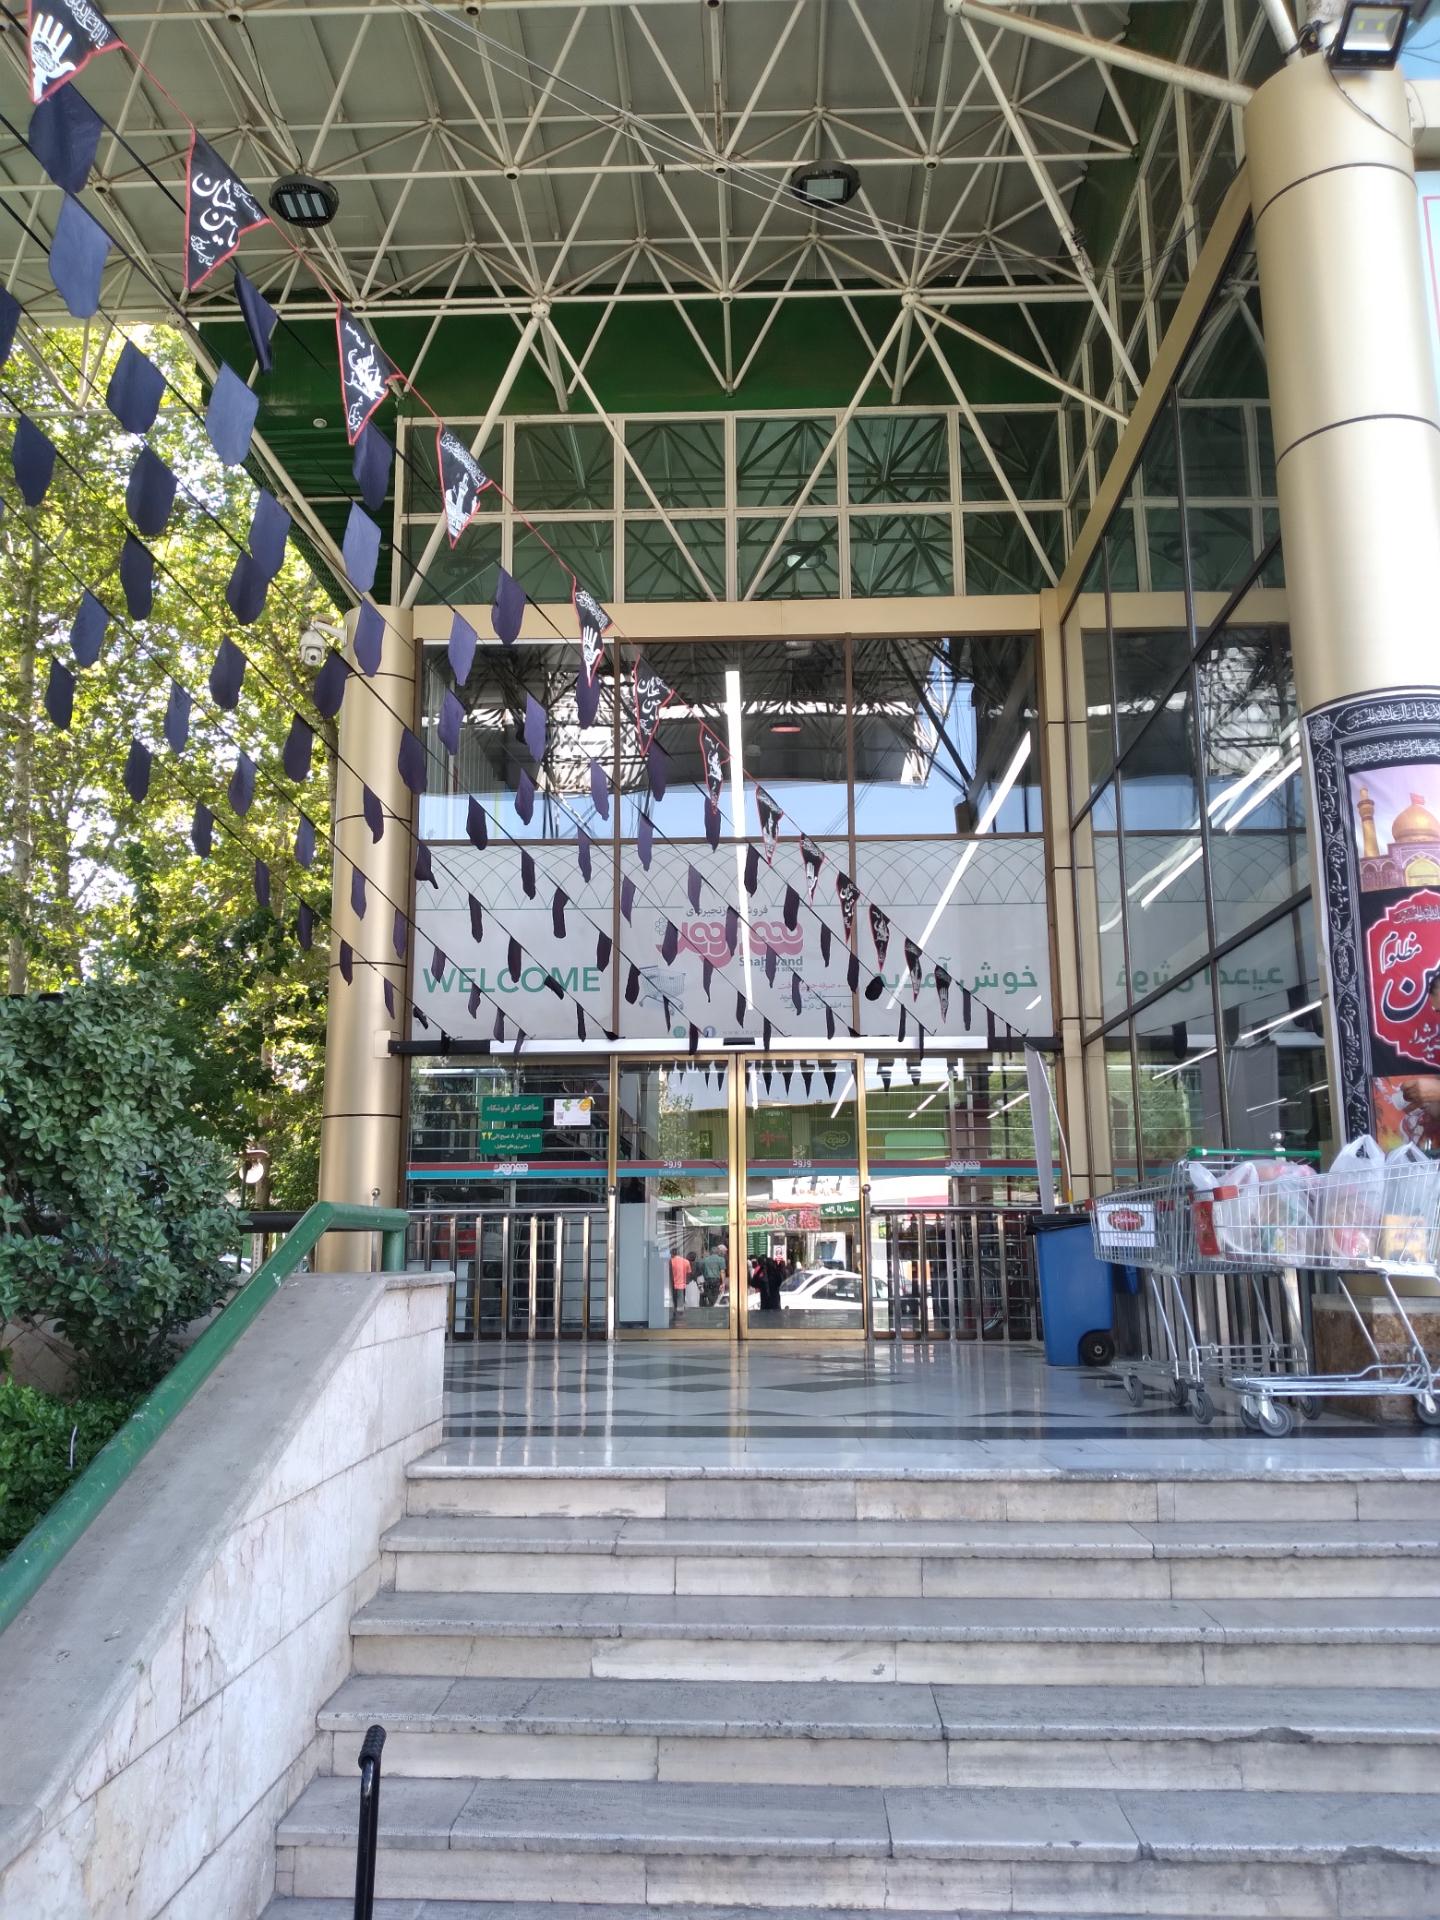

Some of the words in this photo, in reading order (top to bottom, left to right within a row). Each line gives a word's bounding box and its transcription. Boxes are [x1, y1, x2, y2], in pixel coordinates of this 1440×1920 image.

[1379, 930, 1423, 974] مظلوم
[422, 966, 601, 993] WELCOME
[960, 961, 1038, 995] خوش
[486, 1104, 511, 1114] فروشگاه
[511, 1103, 521, 1113] کار
[521, 1104, 540, 1112] ساعت
[481, 1131, 493, 1140] ۲۲
[663, 1159, 683, 1169] ورود
[792, 1159, 812, 1169] ورود
